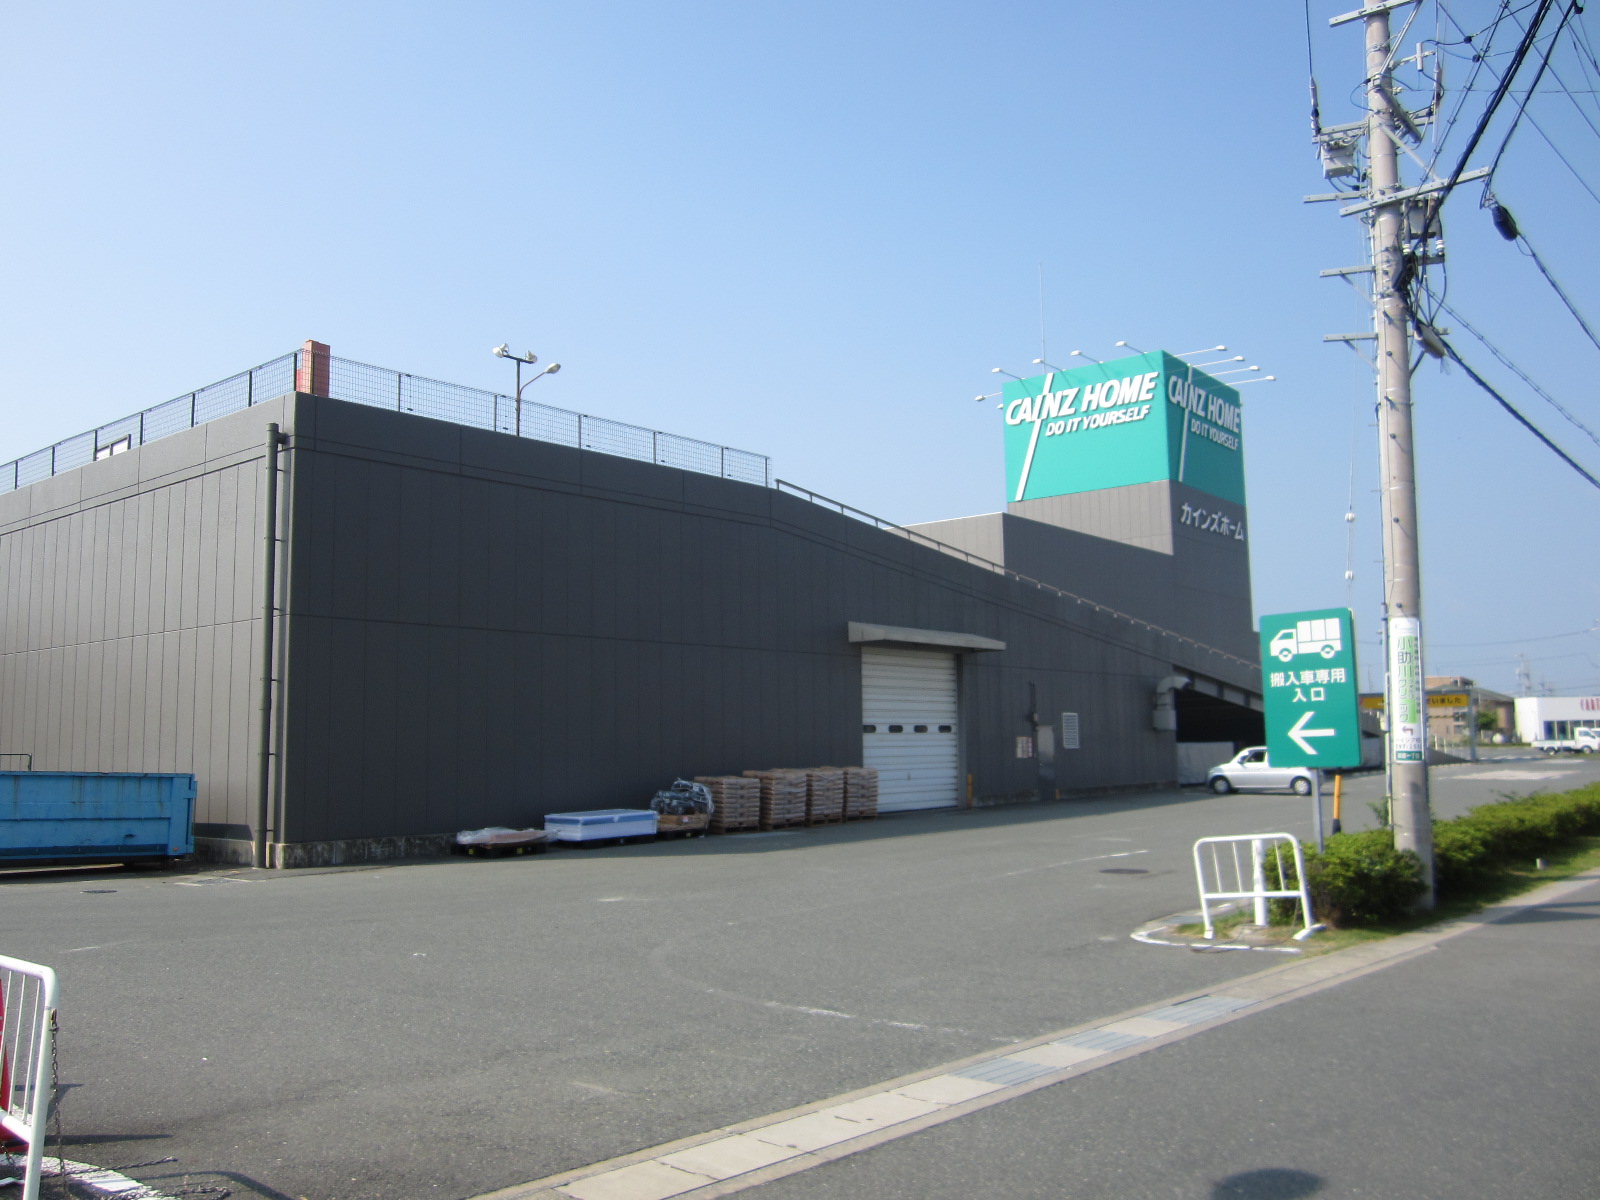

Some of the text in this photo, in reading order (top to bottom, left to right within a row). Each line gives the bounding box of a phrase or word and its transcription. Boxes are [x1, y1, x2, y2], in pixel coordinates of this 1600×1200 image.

[1005, 372, 1159, 425] CAINZ HOME
[1168, 376, 1241, 433] CAINZ HOME
[1045, 405, 1150, 437] DO IT YOURSELF
[1191, 419, 1239, 450] DO IT YOURSELF
[1181, 502, 1245, 541] カインズホーム
[1270, 667, 1346, 687] 搬入車専用
[1292, 687, 1325, 703] 入口
